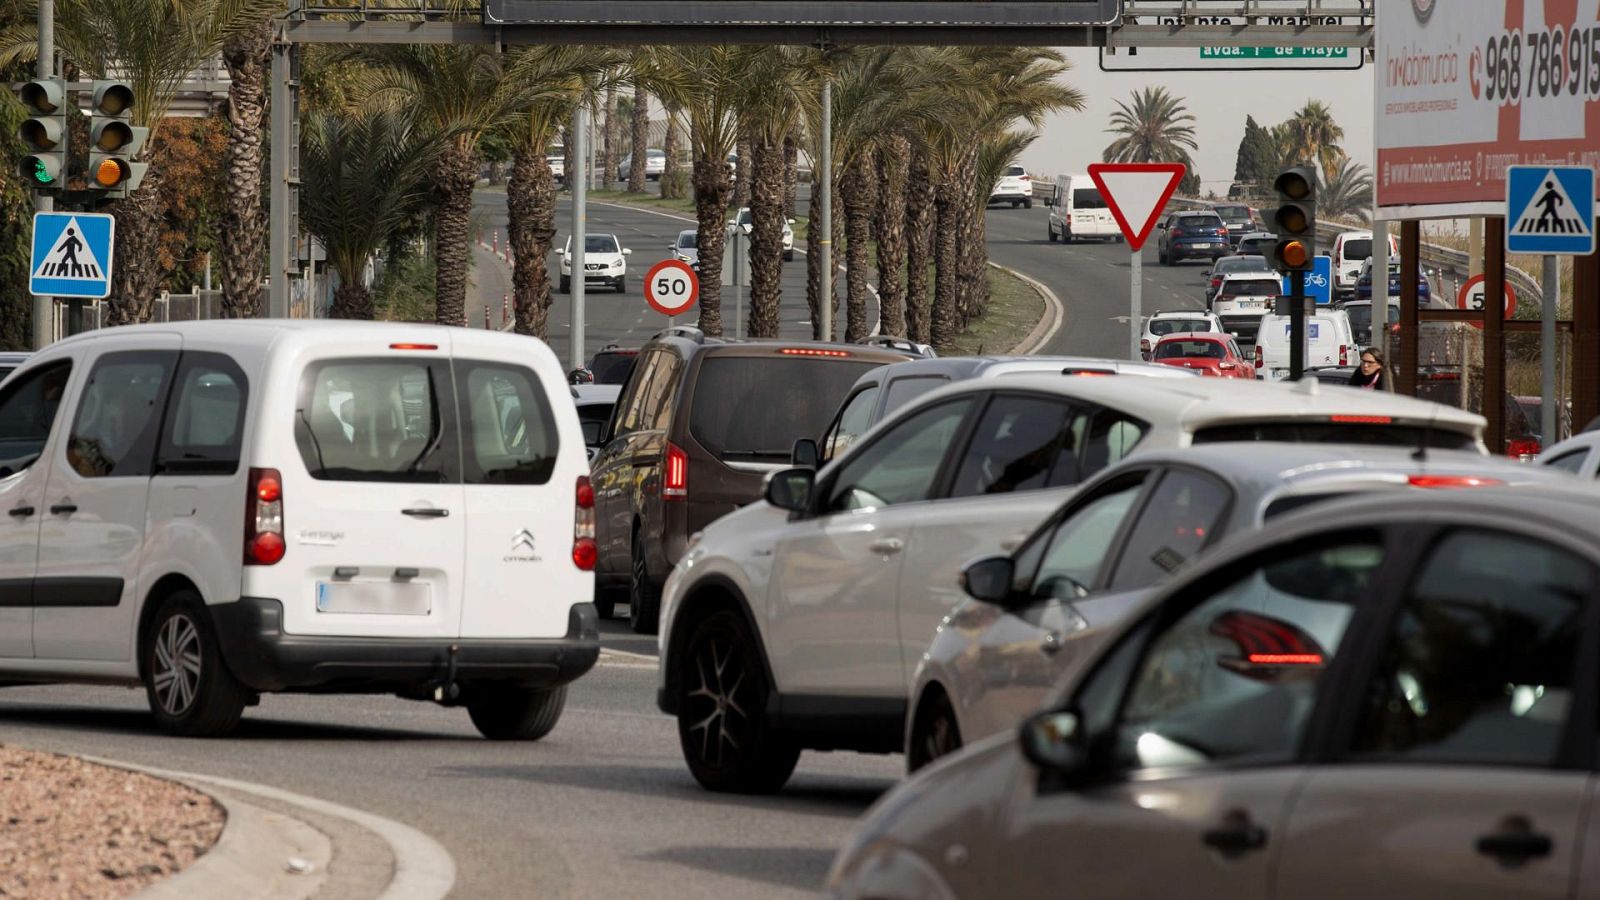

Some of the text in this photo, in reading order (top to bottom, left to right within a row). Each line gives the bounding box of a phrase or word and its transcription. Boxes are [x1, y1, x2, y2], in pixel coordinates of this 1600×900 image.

[1157, 16, 1231, 25] Infnte
[1275, 46, 1294, 56] de
[1302, 46, 1344, 58] Mayo
[1486, 27, 1600, 101] 968 786 915
[657, 278, 686, 296] 50
[1472, 292, 1486, 310] 5
